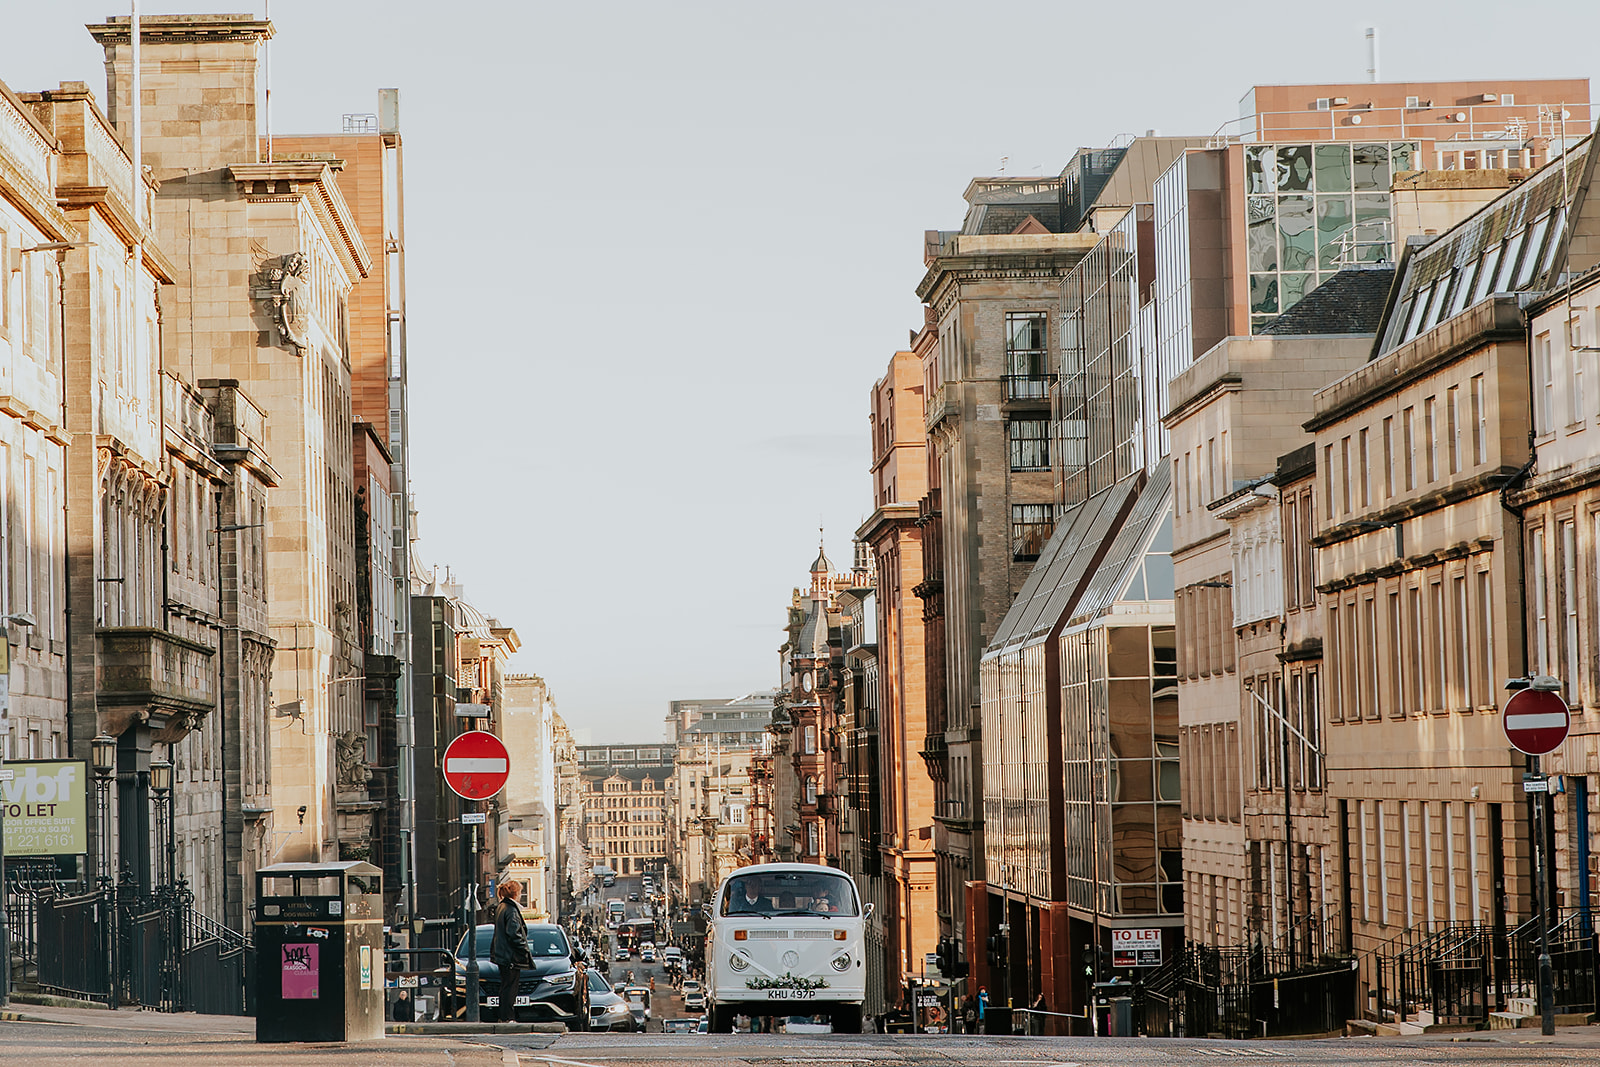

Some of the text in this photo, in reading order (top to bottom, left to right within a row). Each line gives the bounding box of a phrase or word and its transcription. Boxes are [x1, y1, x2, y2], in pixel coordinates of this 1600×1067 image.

[27, 803, 57, 817] LET
[18, 835, 40, 847] 221
[44, 834, 74, 847] 6161
[1113, 930, 1161, 941] TO LET
[768, 990, 816, 999] KHU 497P
